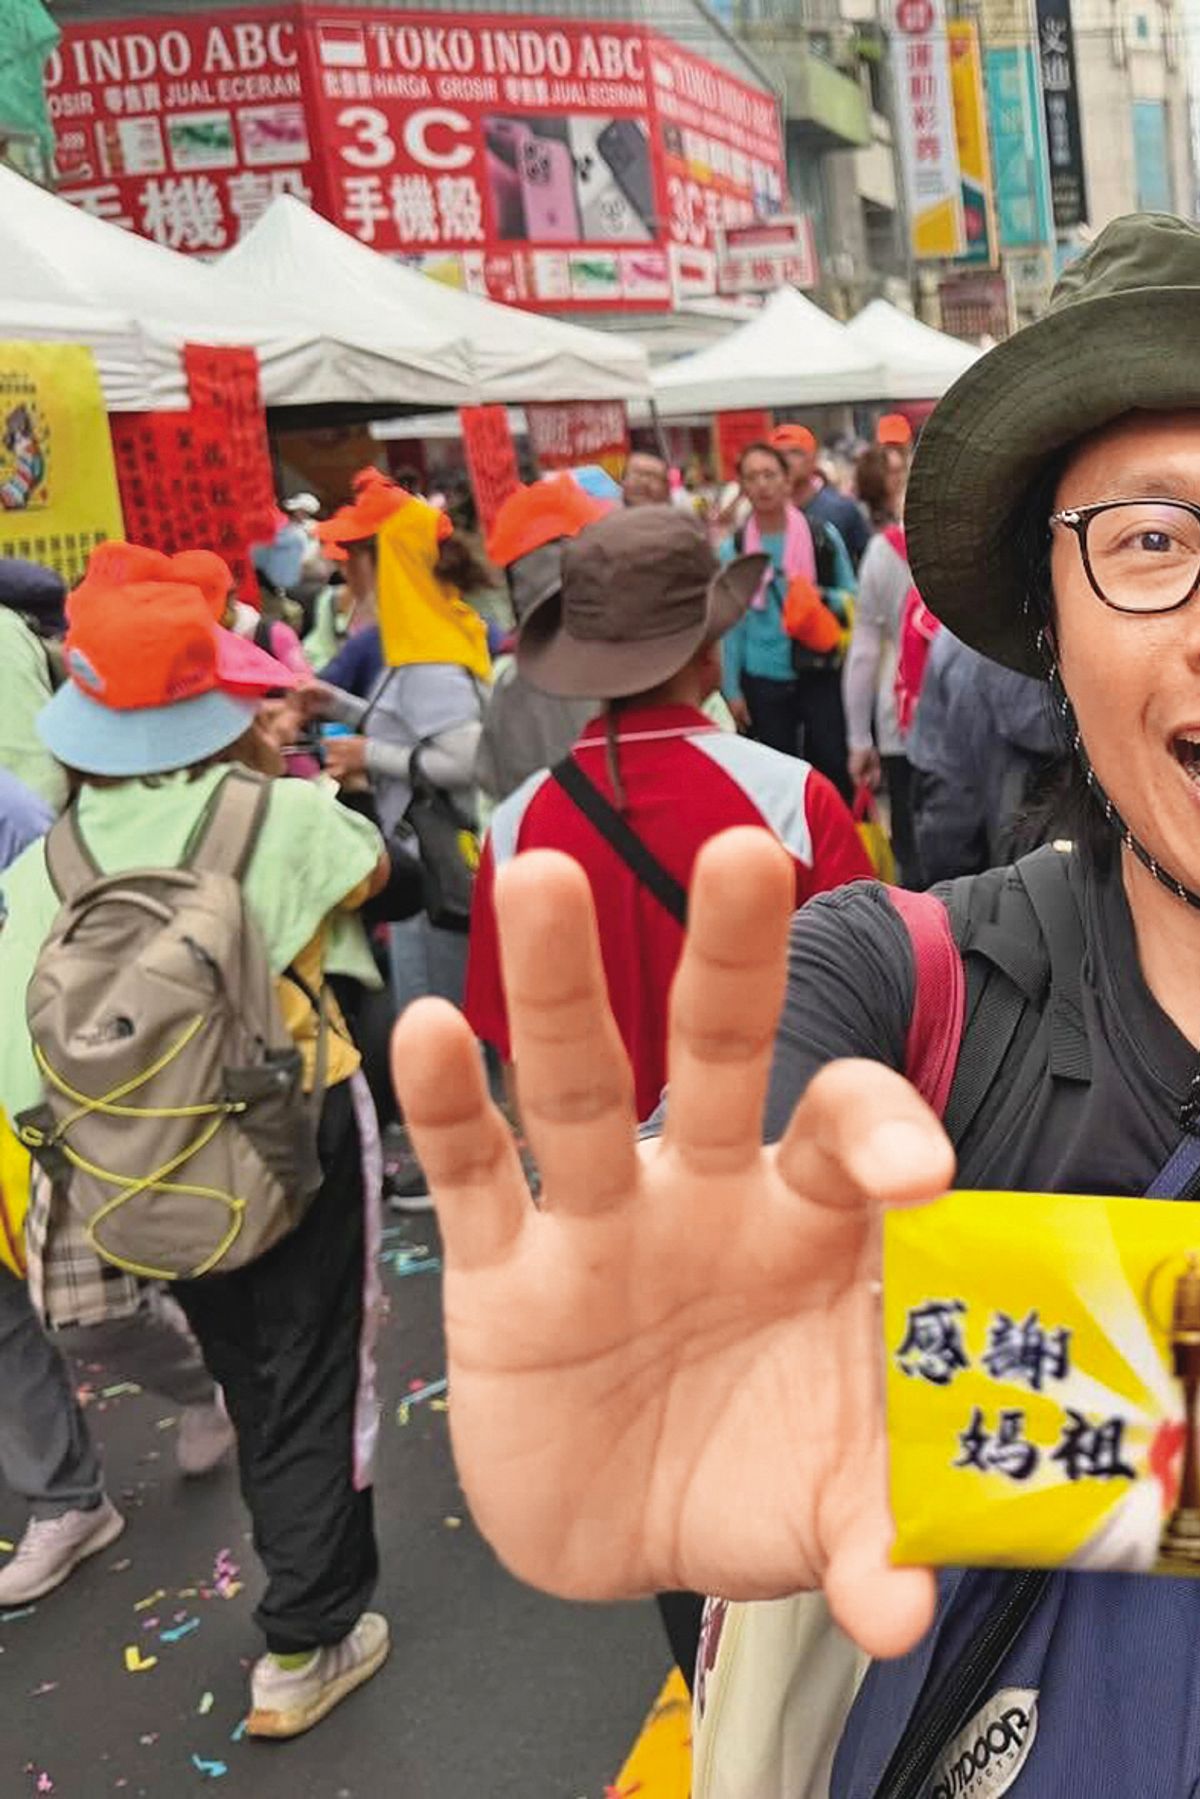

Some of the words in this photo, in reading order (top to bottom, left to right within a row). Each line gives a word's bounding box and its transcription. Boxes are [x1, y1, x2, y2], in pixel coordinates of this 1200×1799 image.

[72, 29, 193, 85] INDO
[203, 21, 298, 73] ABC
[369, 22, 475, 72] TOKO
[480, 28, 572, 77] INDO
[578, 33, 645, 81] ABC
[165, 79, 215, 107] JUAL
[217, 71, 300, 101] ECERAN
[437, 77, 499, 102] GROSIR
[336, 106, 475, 169] 3C
[341, 174, 485, 243] 手機殼
[895, 1299, 1073, 1392] 感謝
[953, 1406, 1138, 1482] 媽祖
